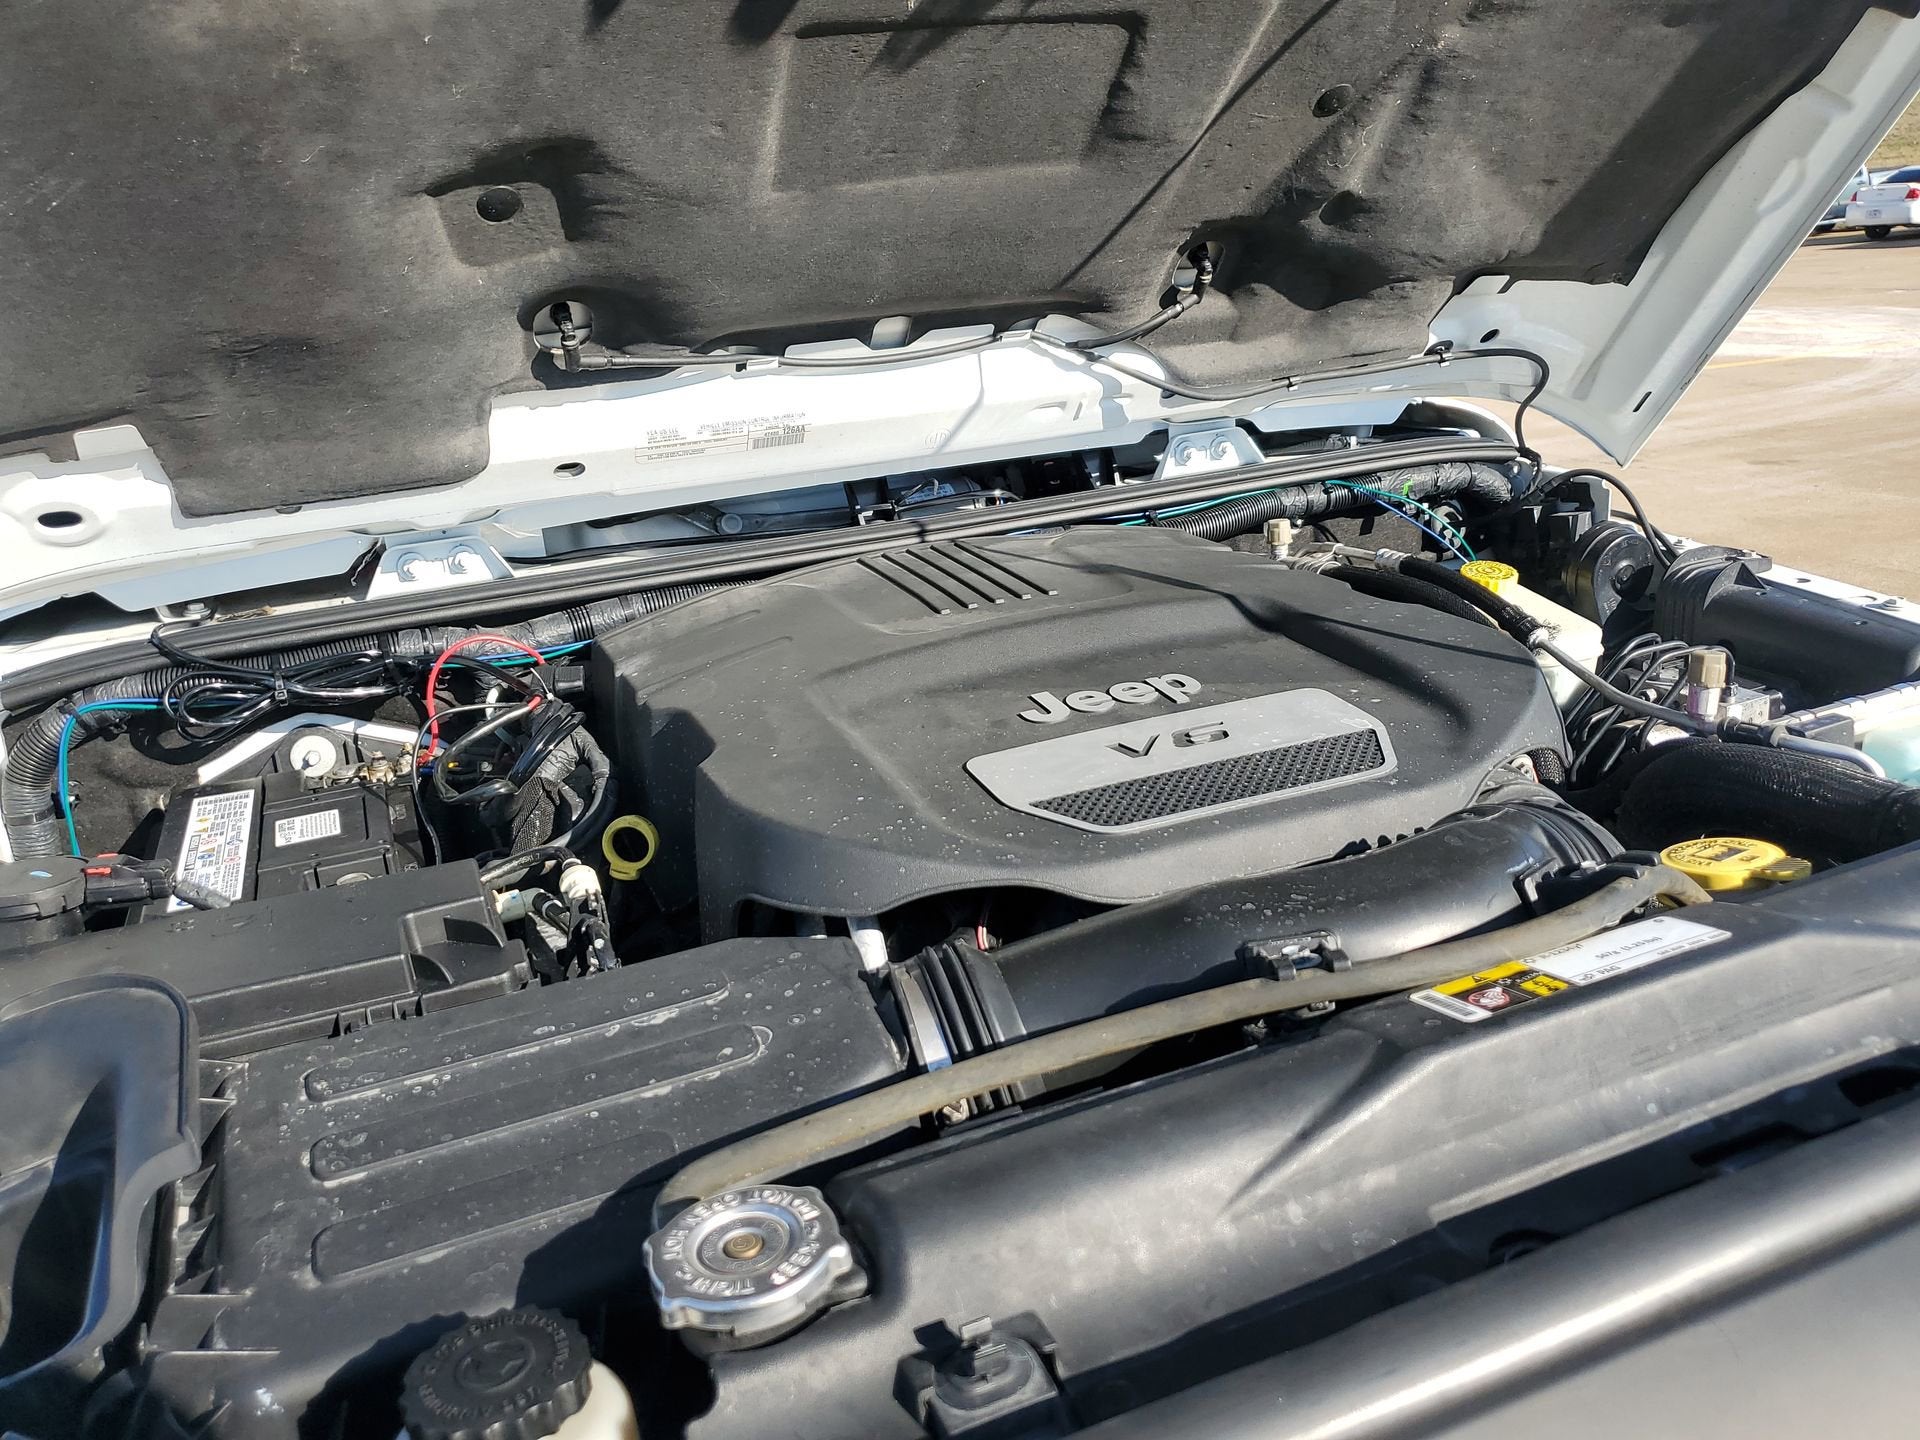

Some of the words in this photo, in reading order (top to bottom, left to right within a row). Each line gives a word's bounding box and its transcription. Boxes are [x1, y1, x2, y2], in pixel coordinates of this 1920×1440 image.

[782, 424, 806, 435] 126AA
[1017, 672, 1202, 724] Jeep
[1105, 720, 1231, 759] V6
[1596, 965, 1622, 975] PAG
[684, 1192, 741, 1226] OPEN
[747, 1188, 793, 1206] NOT
[662, 1228, 689, 1262] HOT
[684, 1276, 757, 1297] TIGHT
